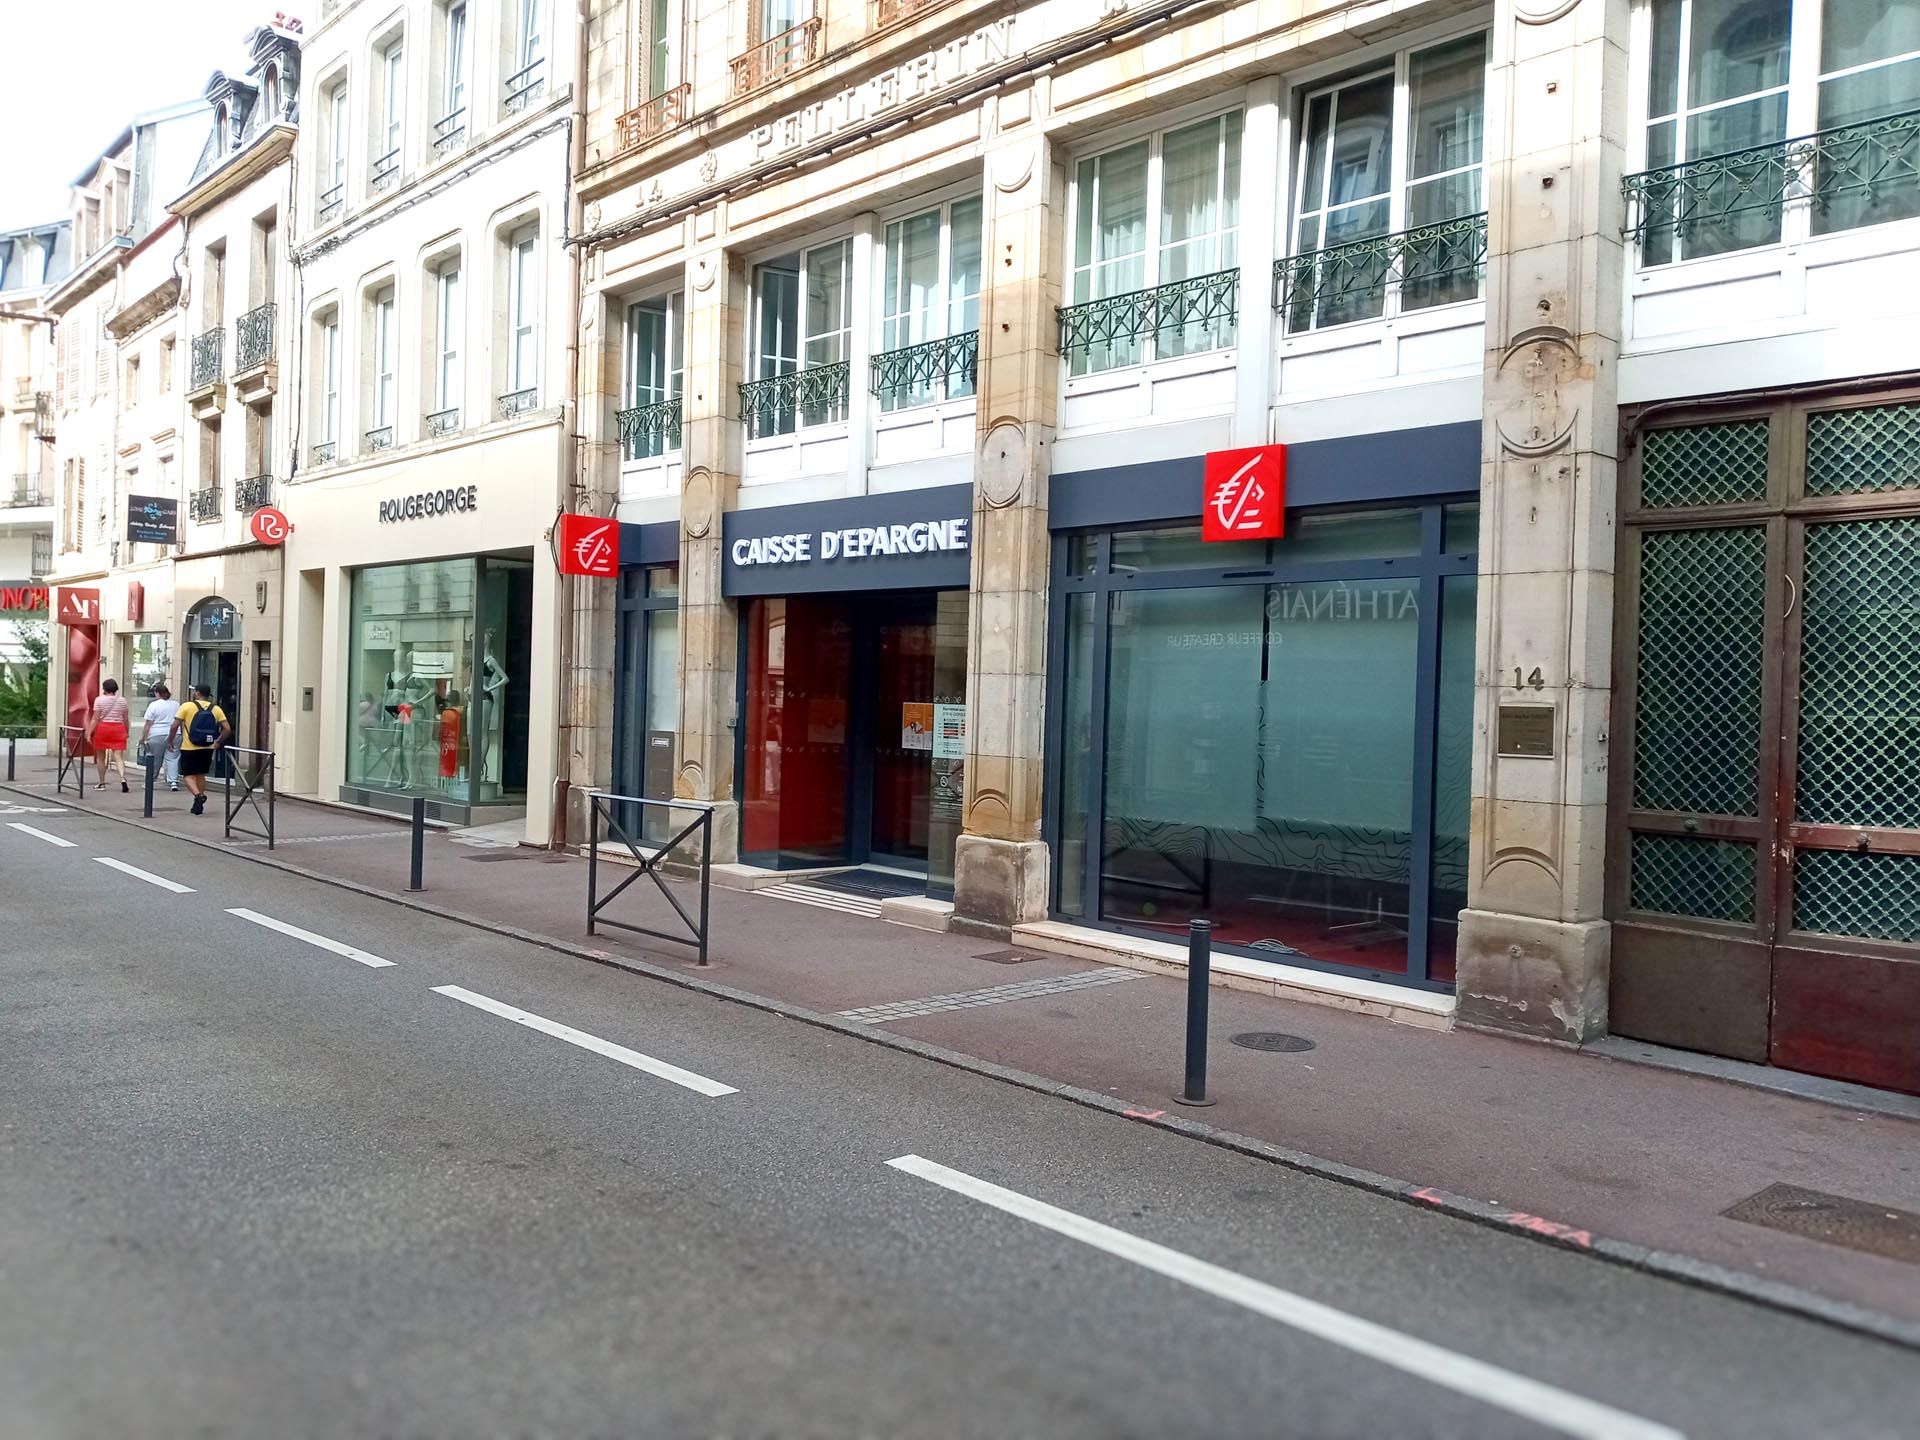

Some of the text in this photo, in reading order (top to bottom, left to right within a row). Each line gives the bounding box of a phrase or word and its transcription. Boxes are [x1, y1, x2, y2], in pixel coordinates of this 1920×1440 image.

[379, 485, 477, 523] ROUGEGORGE
[732, 533, 812, 566] CAISSE
[1512, 667, 1545, 692] 14
